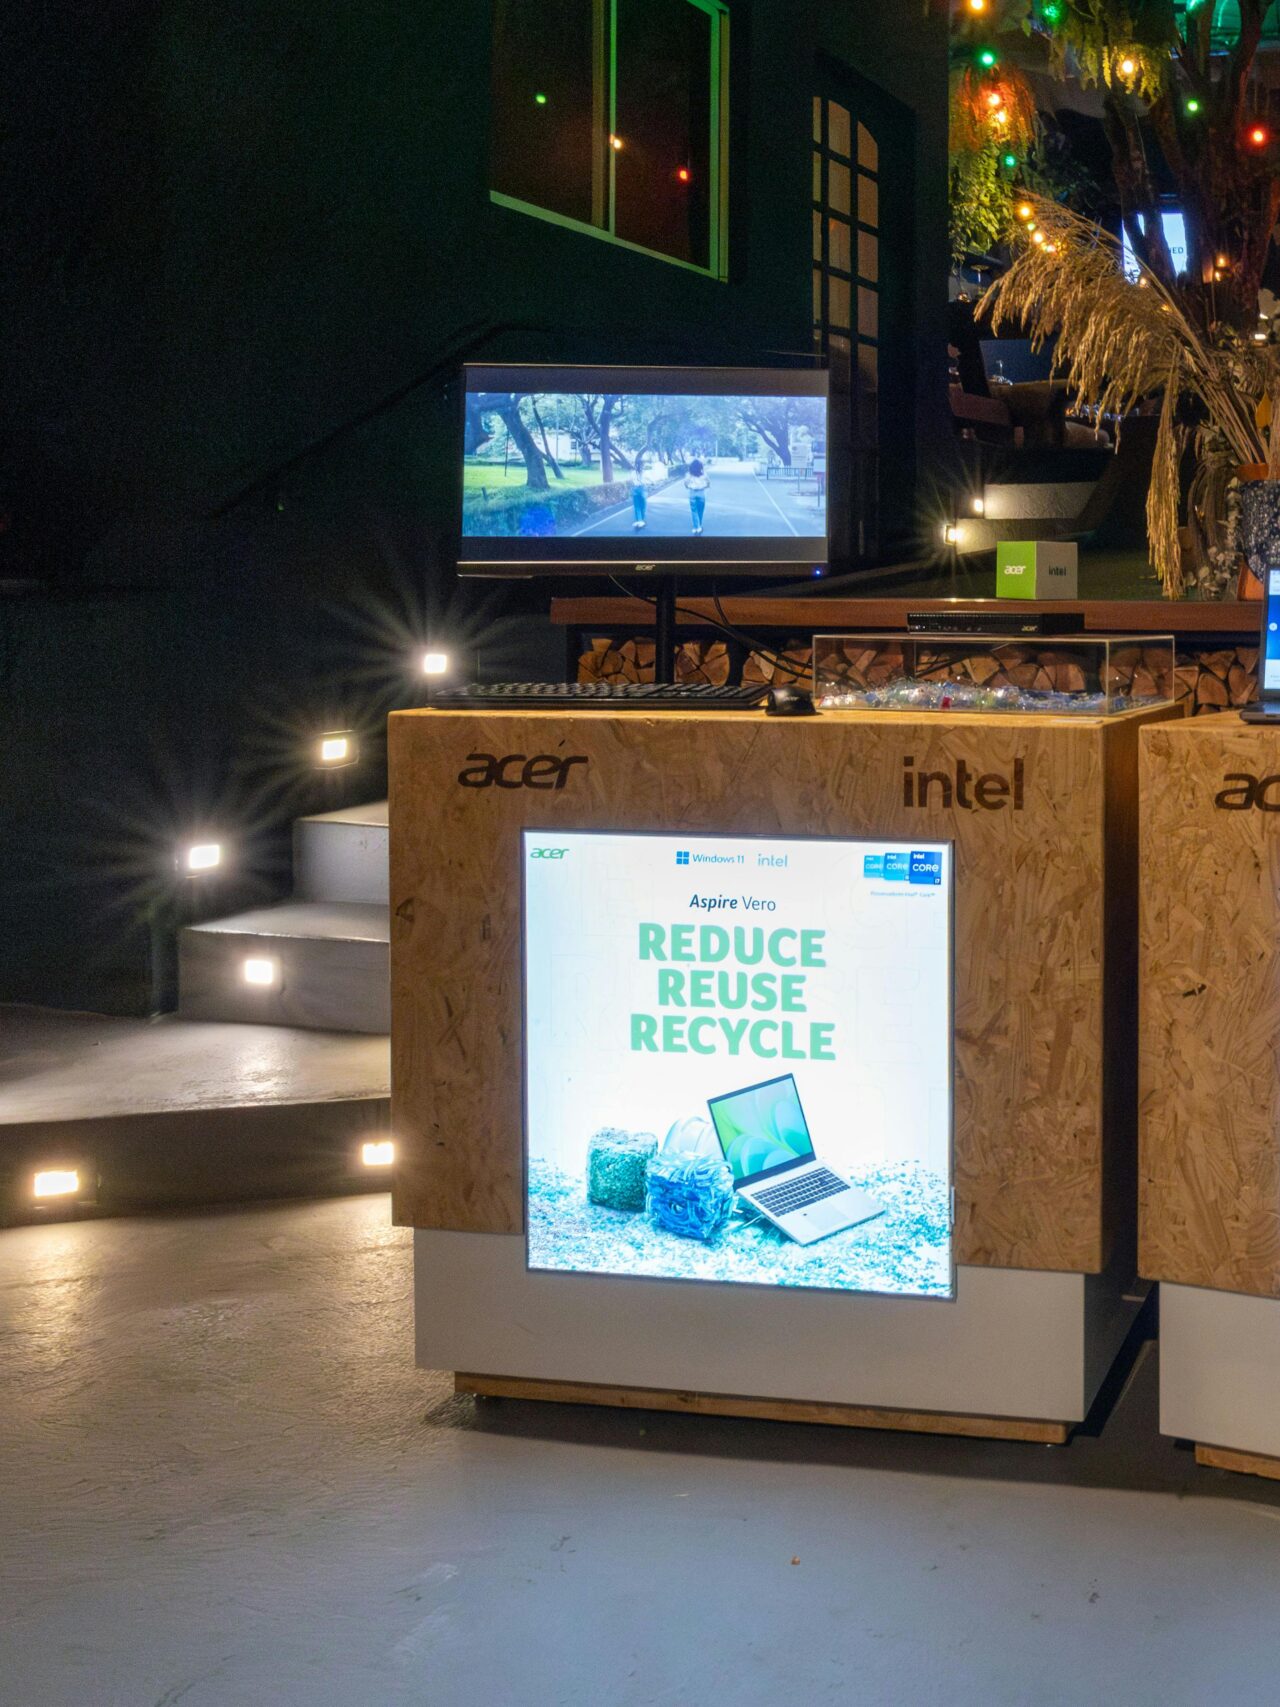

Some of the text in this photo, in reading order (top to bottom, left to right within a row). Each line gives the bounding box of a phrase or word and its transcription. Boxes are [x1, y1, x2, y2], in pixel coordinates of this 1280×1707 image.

[1004, 565, 1026, 575] acer
[1048, 564, 1067, 576] intel
[458, 753, 589, 789] acer
[903, 756, 1024, 810] intel
[530, 848, 570, 859] acer
[692, 854, 745, 864] Windows 11
[757, 854, 788, 867] intel
[689, 894, 776, 912] Aspire Vero
[639, 922, 827, 968] REDUCE
[658, 968, 807, 1013] REUSE
[630, 1013, 837, 1061] RECYCLE
